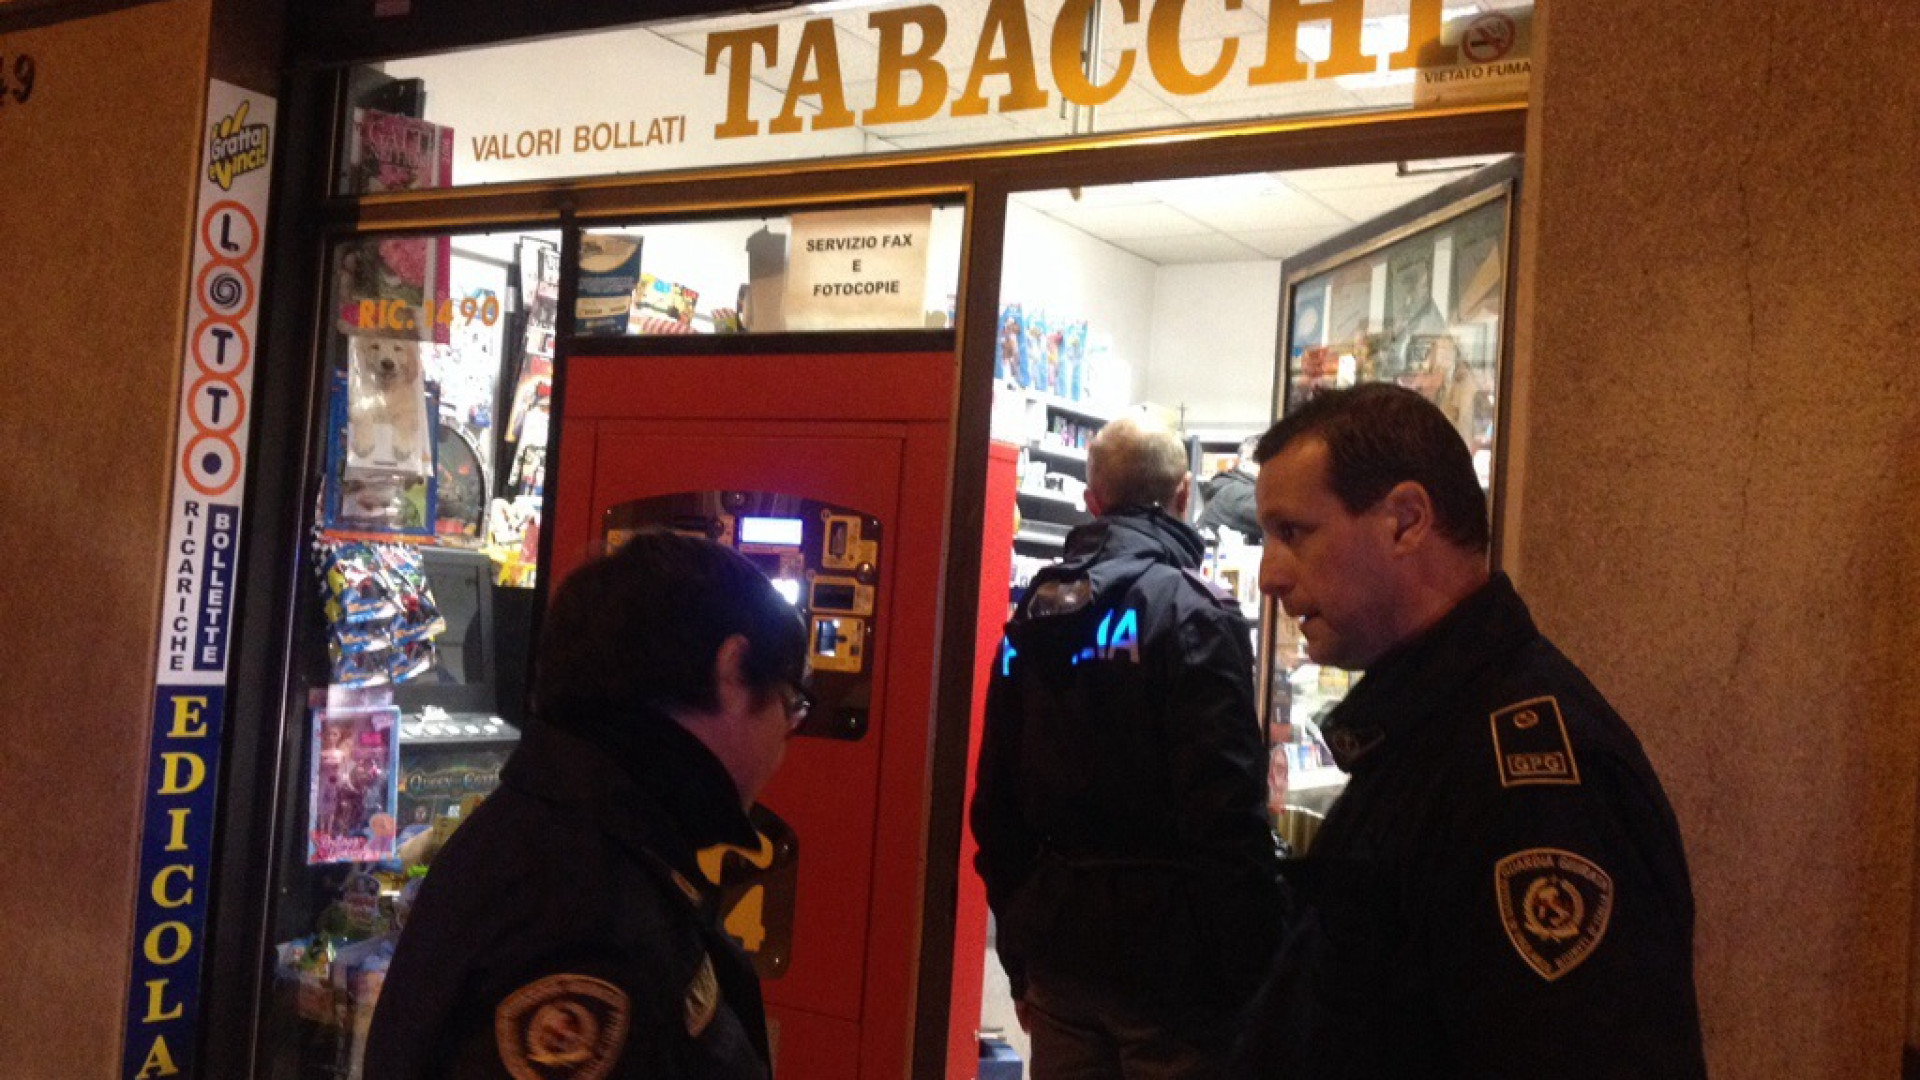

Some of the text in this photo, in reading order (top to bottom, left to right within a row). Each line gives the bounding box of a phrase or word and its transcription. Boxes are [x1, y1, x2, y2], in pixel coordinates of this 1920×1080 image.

[706, 0, 1458, 140] TABACCHI
[1424, 66, 1484, 83] VIETATO
[472, 128, 562, 161] VALORI
[573, 115, 686, 153] BOLLATI
[806, 233, 913, 252] SERVIZIO FAX
[852, 259, 862, 272] E
[813, 280, 900, 297] FOTOCOPIE
[359, 295, 500, 330] RIC. 1490
[169, 500, 199, 671] RICARICHE
[202, 513, 230, 663] BOLLETTE
[1514, 755, 1560, 773] GPG
[136, 695, 208, 1080] EDICOLA
